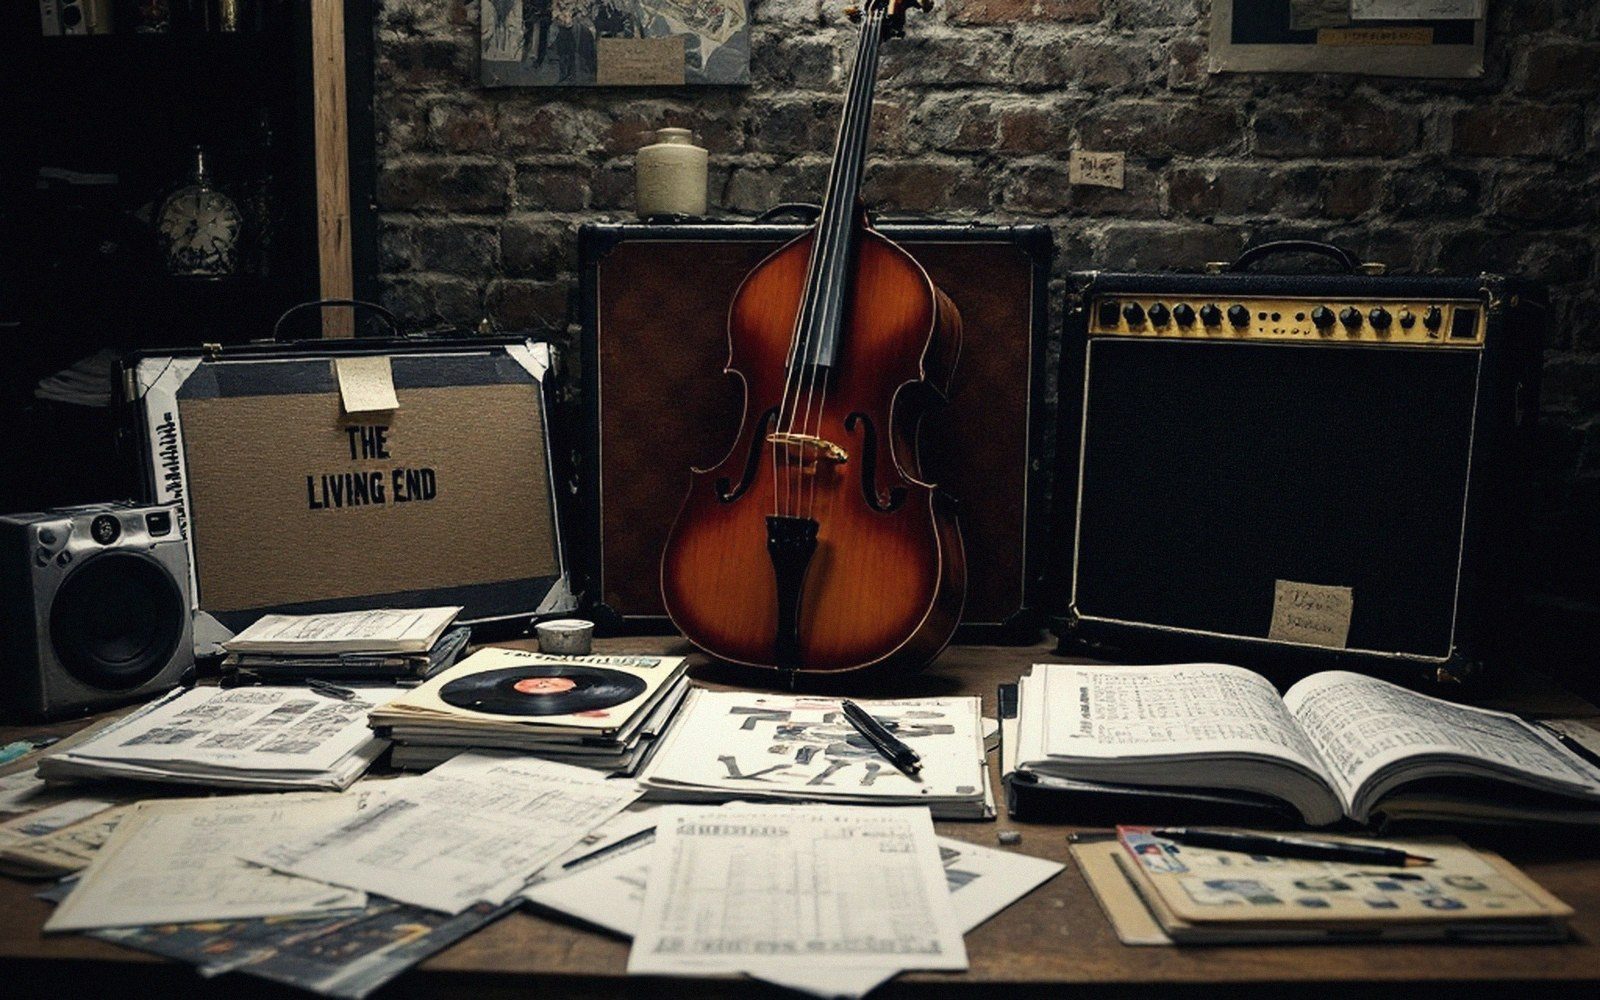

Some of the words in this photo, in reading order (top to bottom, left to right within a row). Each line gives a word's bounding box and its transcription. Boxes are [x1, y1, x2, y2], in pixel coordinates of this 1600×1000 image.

[345, 426, 391, 460] THE
[307, 472, 386, 509] LIVING
[392, 468, 437, 503] END
